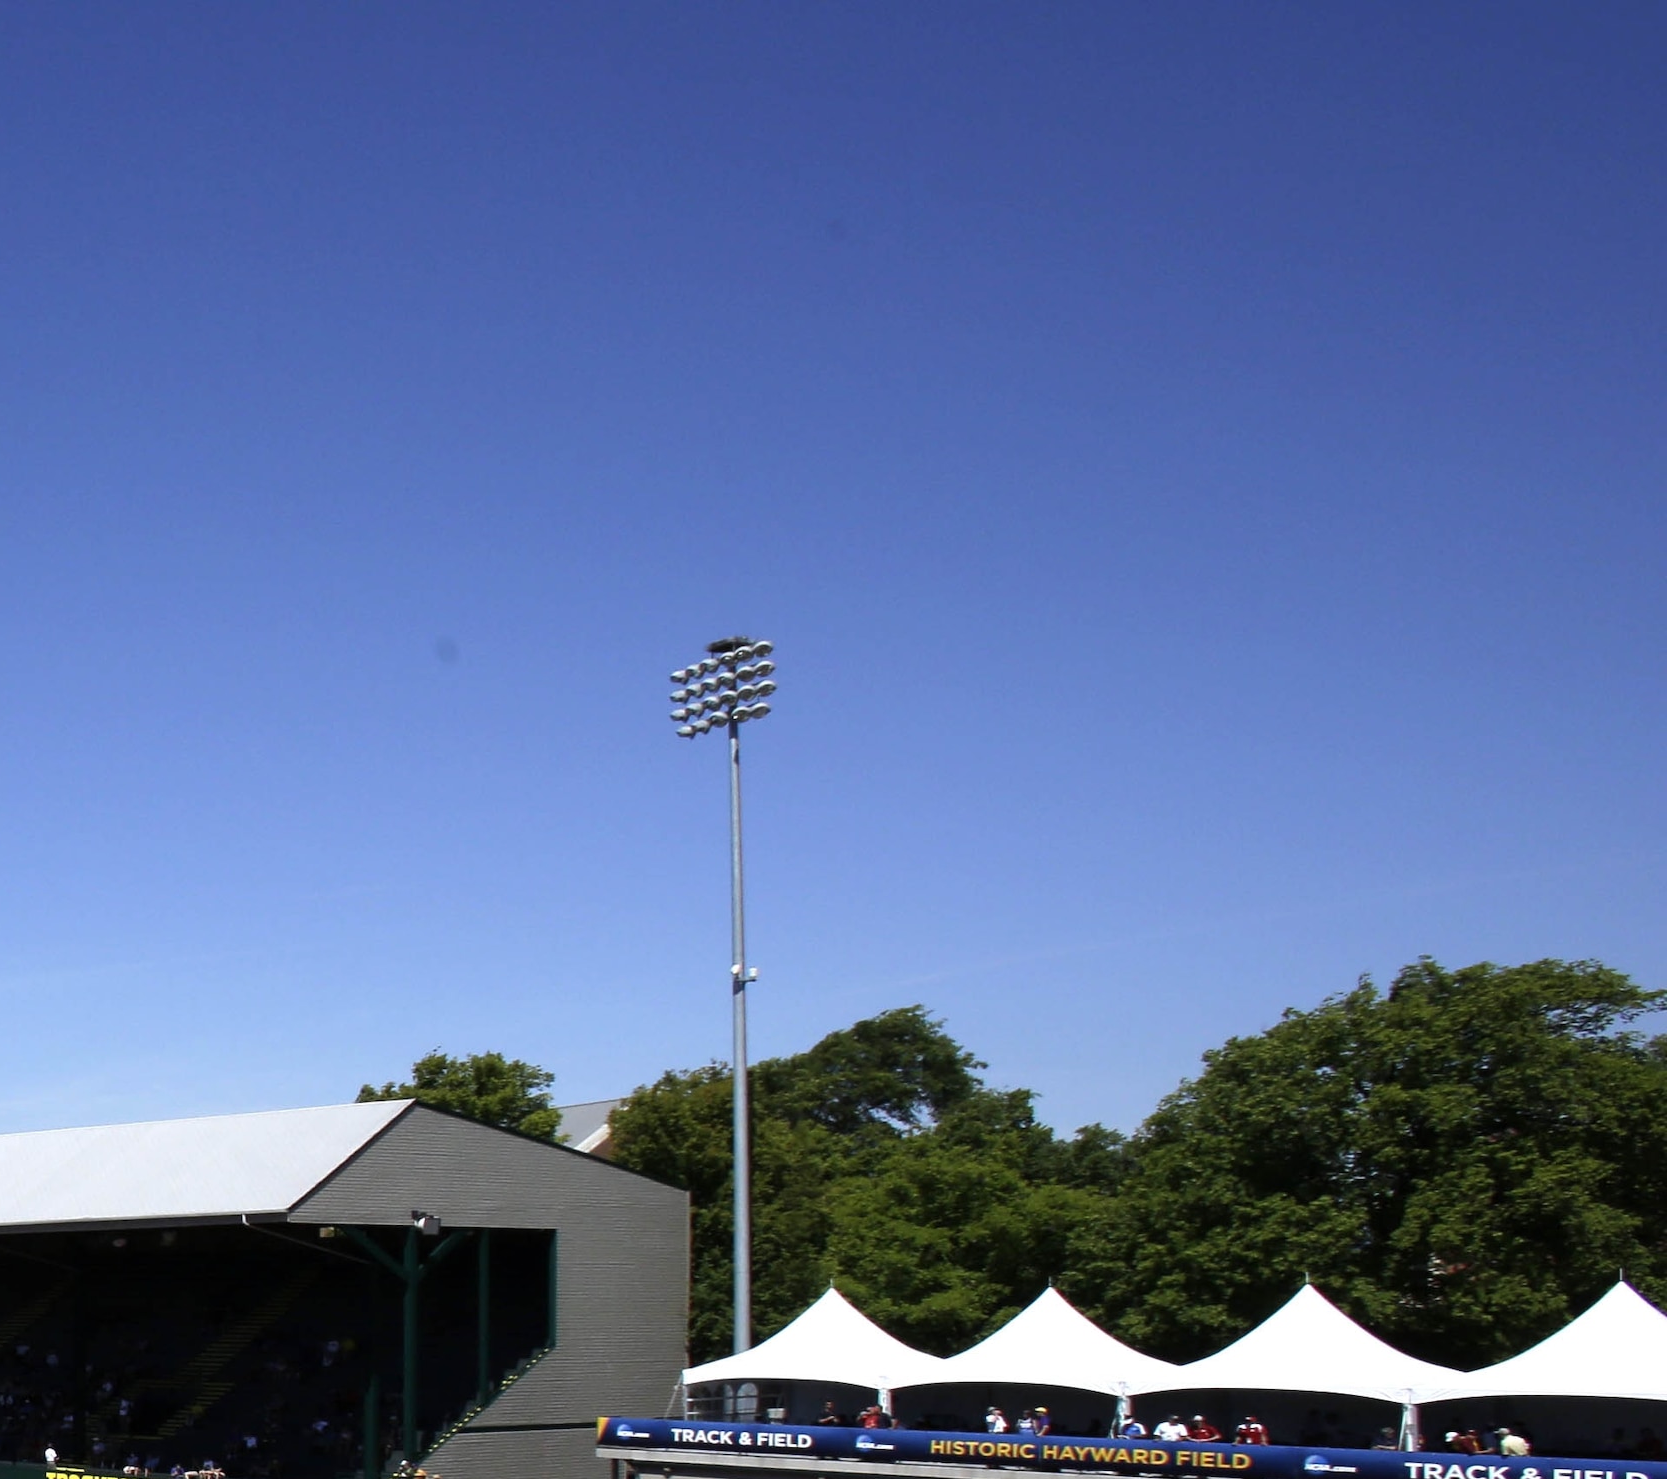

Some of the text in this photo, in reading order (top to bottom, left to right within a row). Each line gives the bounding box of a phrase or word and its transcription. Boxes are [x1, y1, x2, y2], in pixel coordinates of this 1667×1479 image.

[671, 1428, 813, 1448] TRACK & FIELD
[929, 1439, 1252, 1469] HISTORIC HAYWARD FIELD
